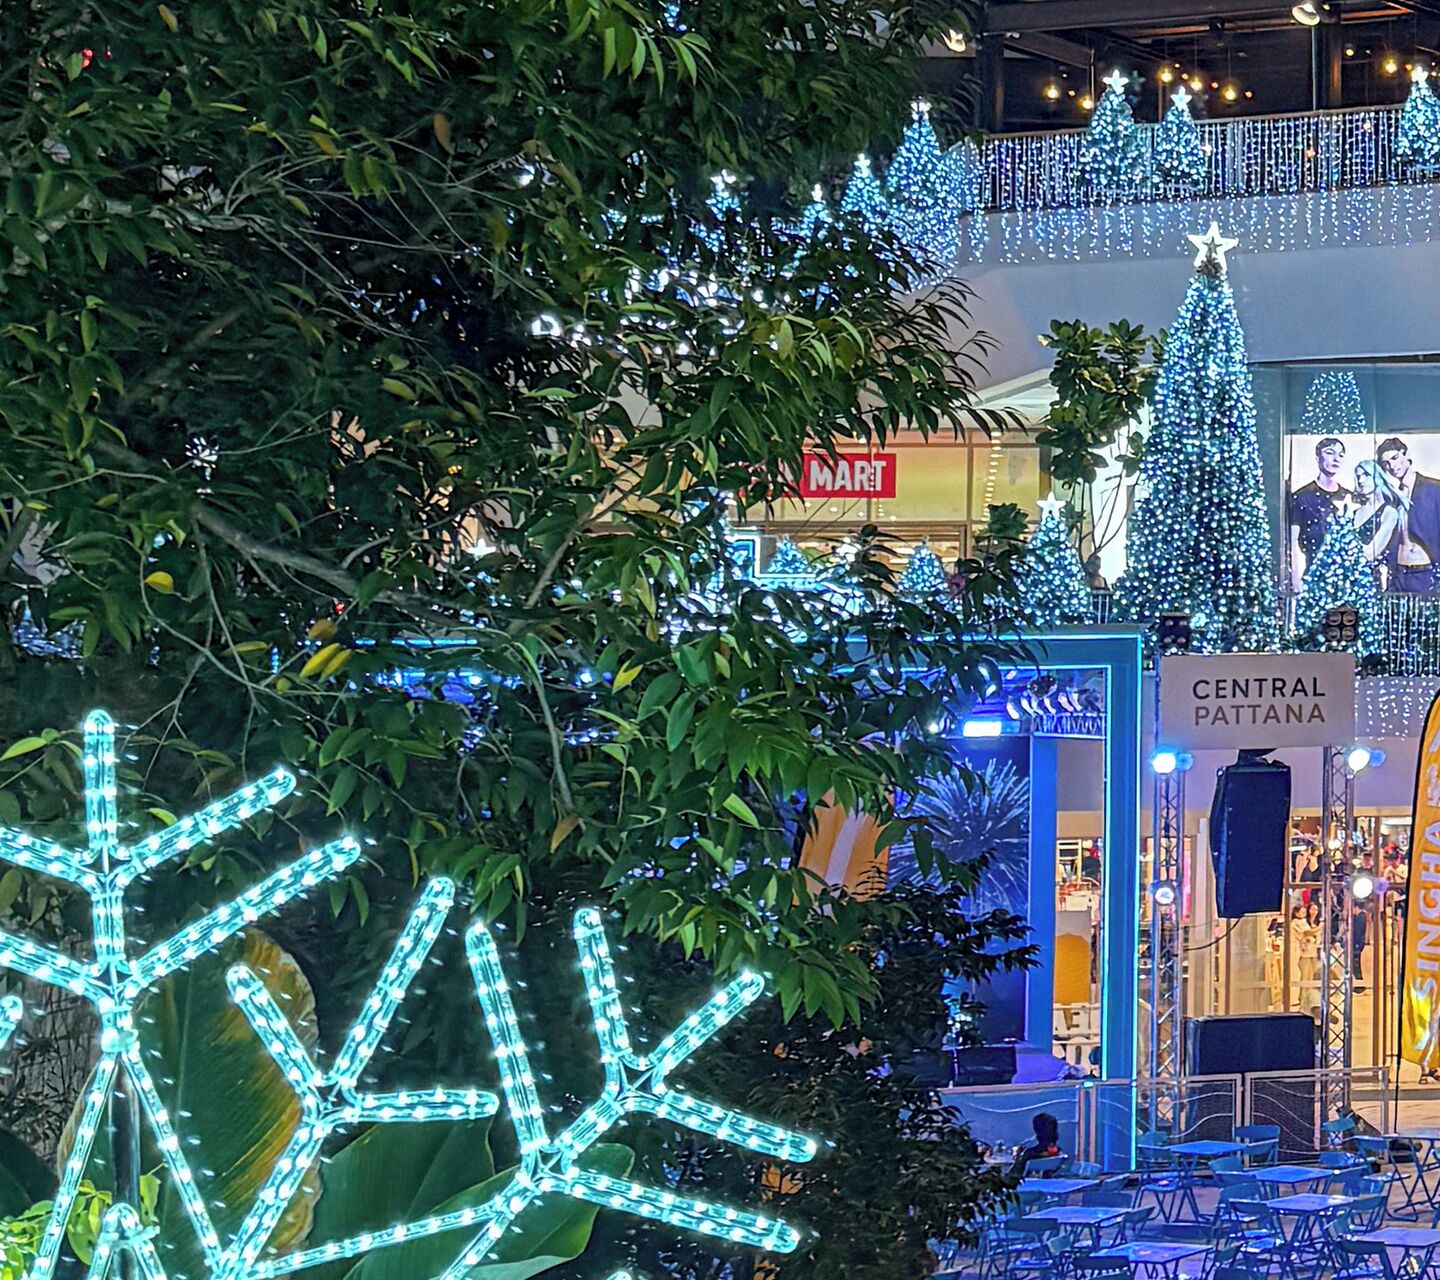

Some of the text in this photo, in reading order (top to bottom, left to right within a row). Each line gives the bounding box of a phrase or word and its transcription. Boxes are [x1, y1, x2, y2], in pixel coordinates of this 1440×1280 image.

[809, 460, 887, 492] MART
[1192, 677, 1326, 700] CENTRAL
[1194, 703, 1326, 726] PATTANA
